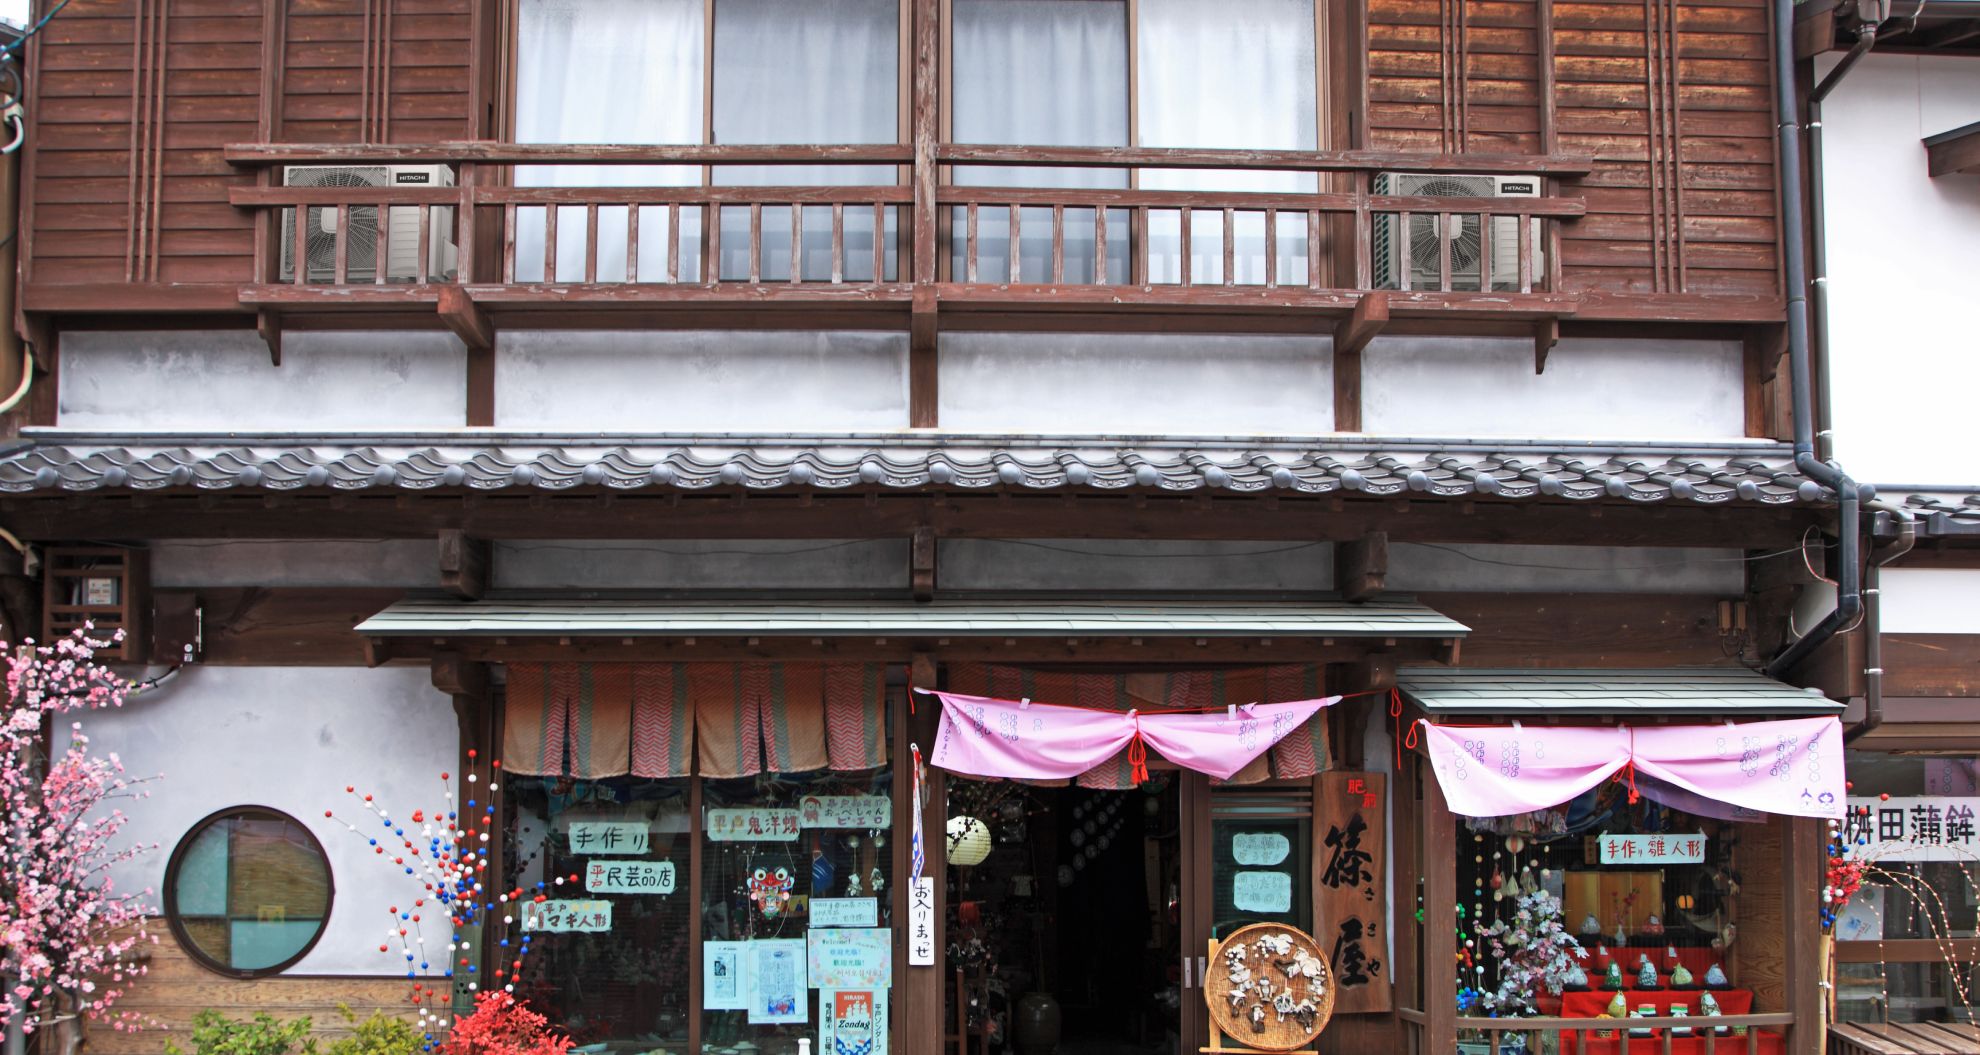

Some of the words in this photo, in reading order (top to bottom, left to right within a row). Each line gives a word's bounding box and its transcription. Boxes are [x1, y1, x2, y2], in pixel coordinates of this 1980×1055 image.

[576, 827, 645, 850] 手作り
[1608, 839, 1701, 859] 手作り雛人形
[590, 864, 606, 887] 平戸
[607, 866, 672, 887] 民芸品店
[544, 903, 567, 913] 平戸
[913, 884, 931, 958] お入りまっせ
[838, 1020, 870, 1030] Zondag
